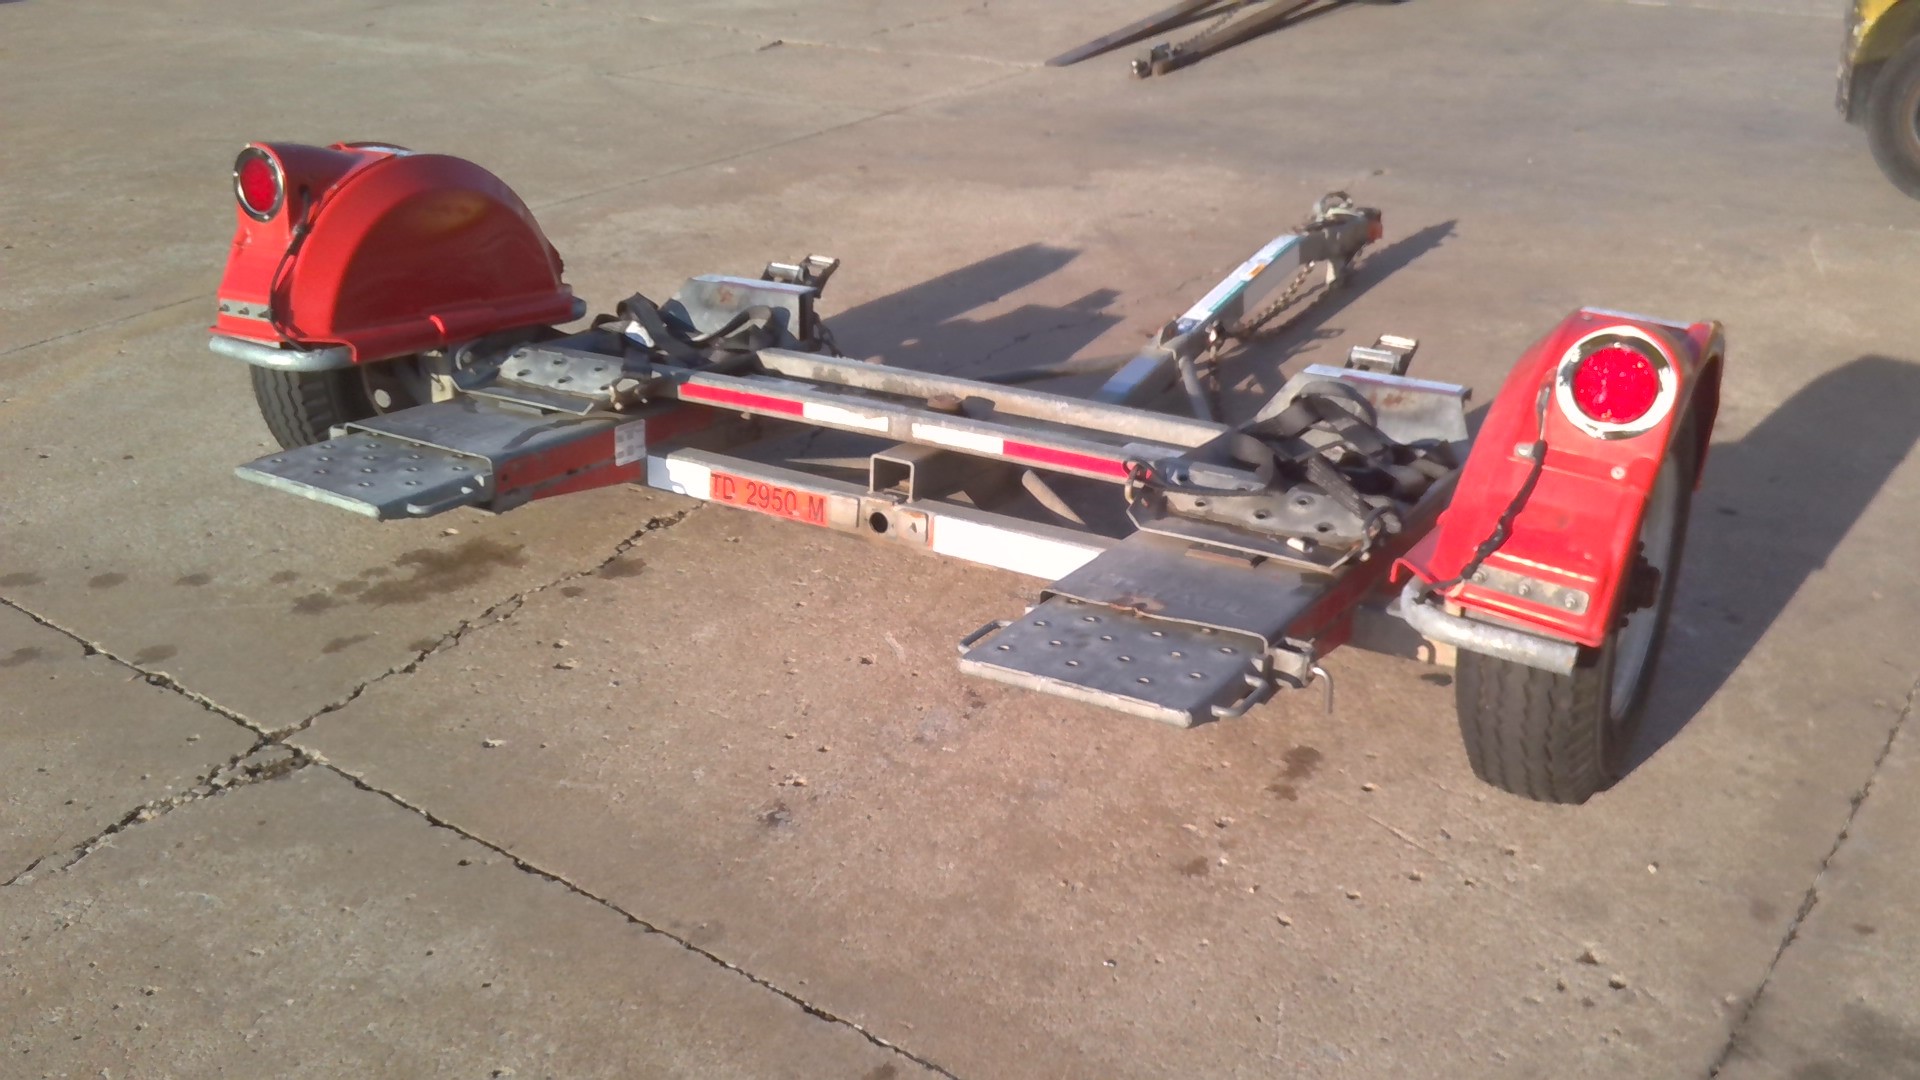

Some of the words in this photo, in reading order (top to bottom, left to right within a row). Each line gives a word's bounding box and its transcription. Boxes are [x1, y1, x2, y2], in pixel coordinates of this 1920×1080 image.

[711, 473, 736, 500] TD
[746, 481, 797, 515] 2950
[808, 496, 825, 523] M
